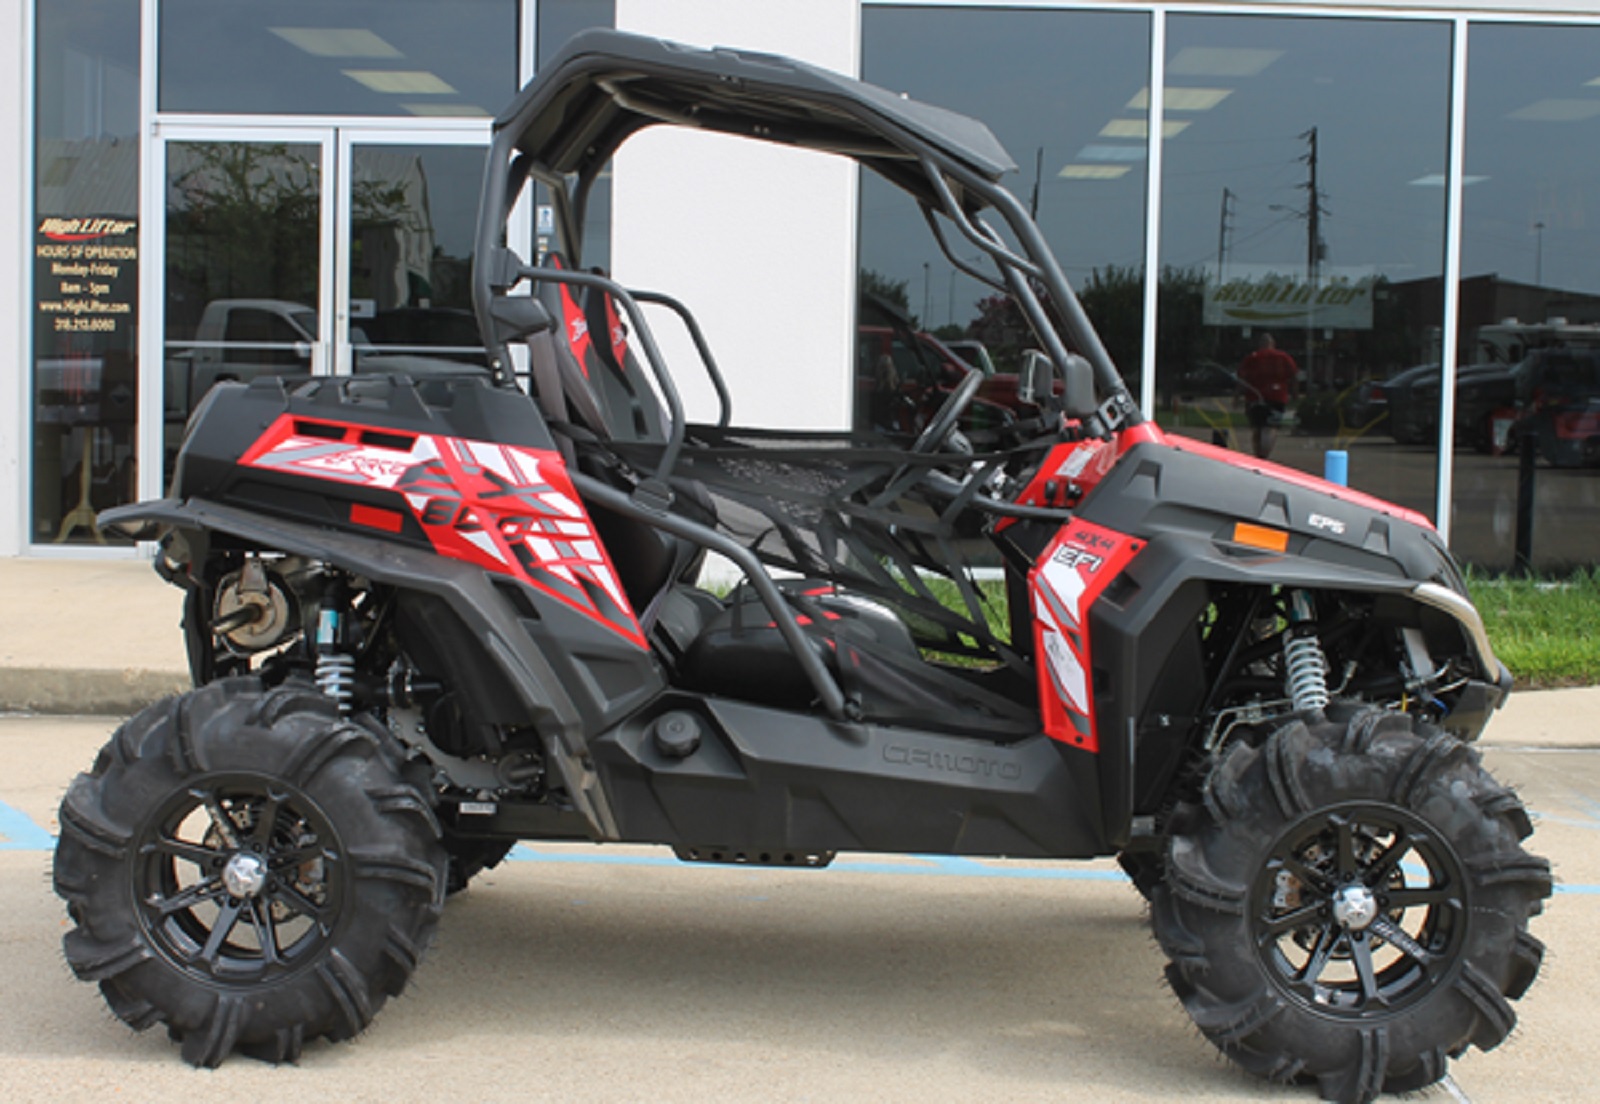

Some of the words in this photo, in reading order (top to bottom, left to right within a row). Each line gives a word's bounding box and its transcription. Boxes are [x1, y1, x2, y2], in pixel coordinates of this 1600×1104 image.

[37, 245, 68, 258] HOURS
[71, 245, 83, 259] OF
[85, 246, 137, 260] OPERATION
[90, 282, 110, 296] 5pm
[1308, 514, 1346, 535] EPS
[1053, 543, 1104, 573] EFI
